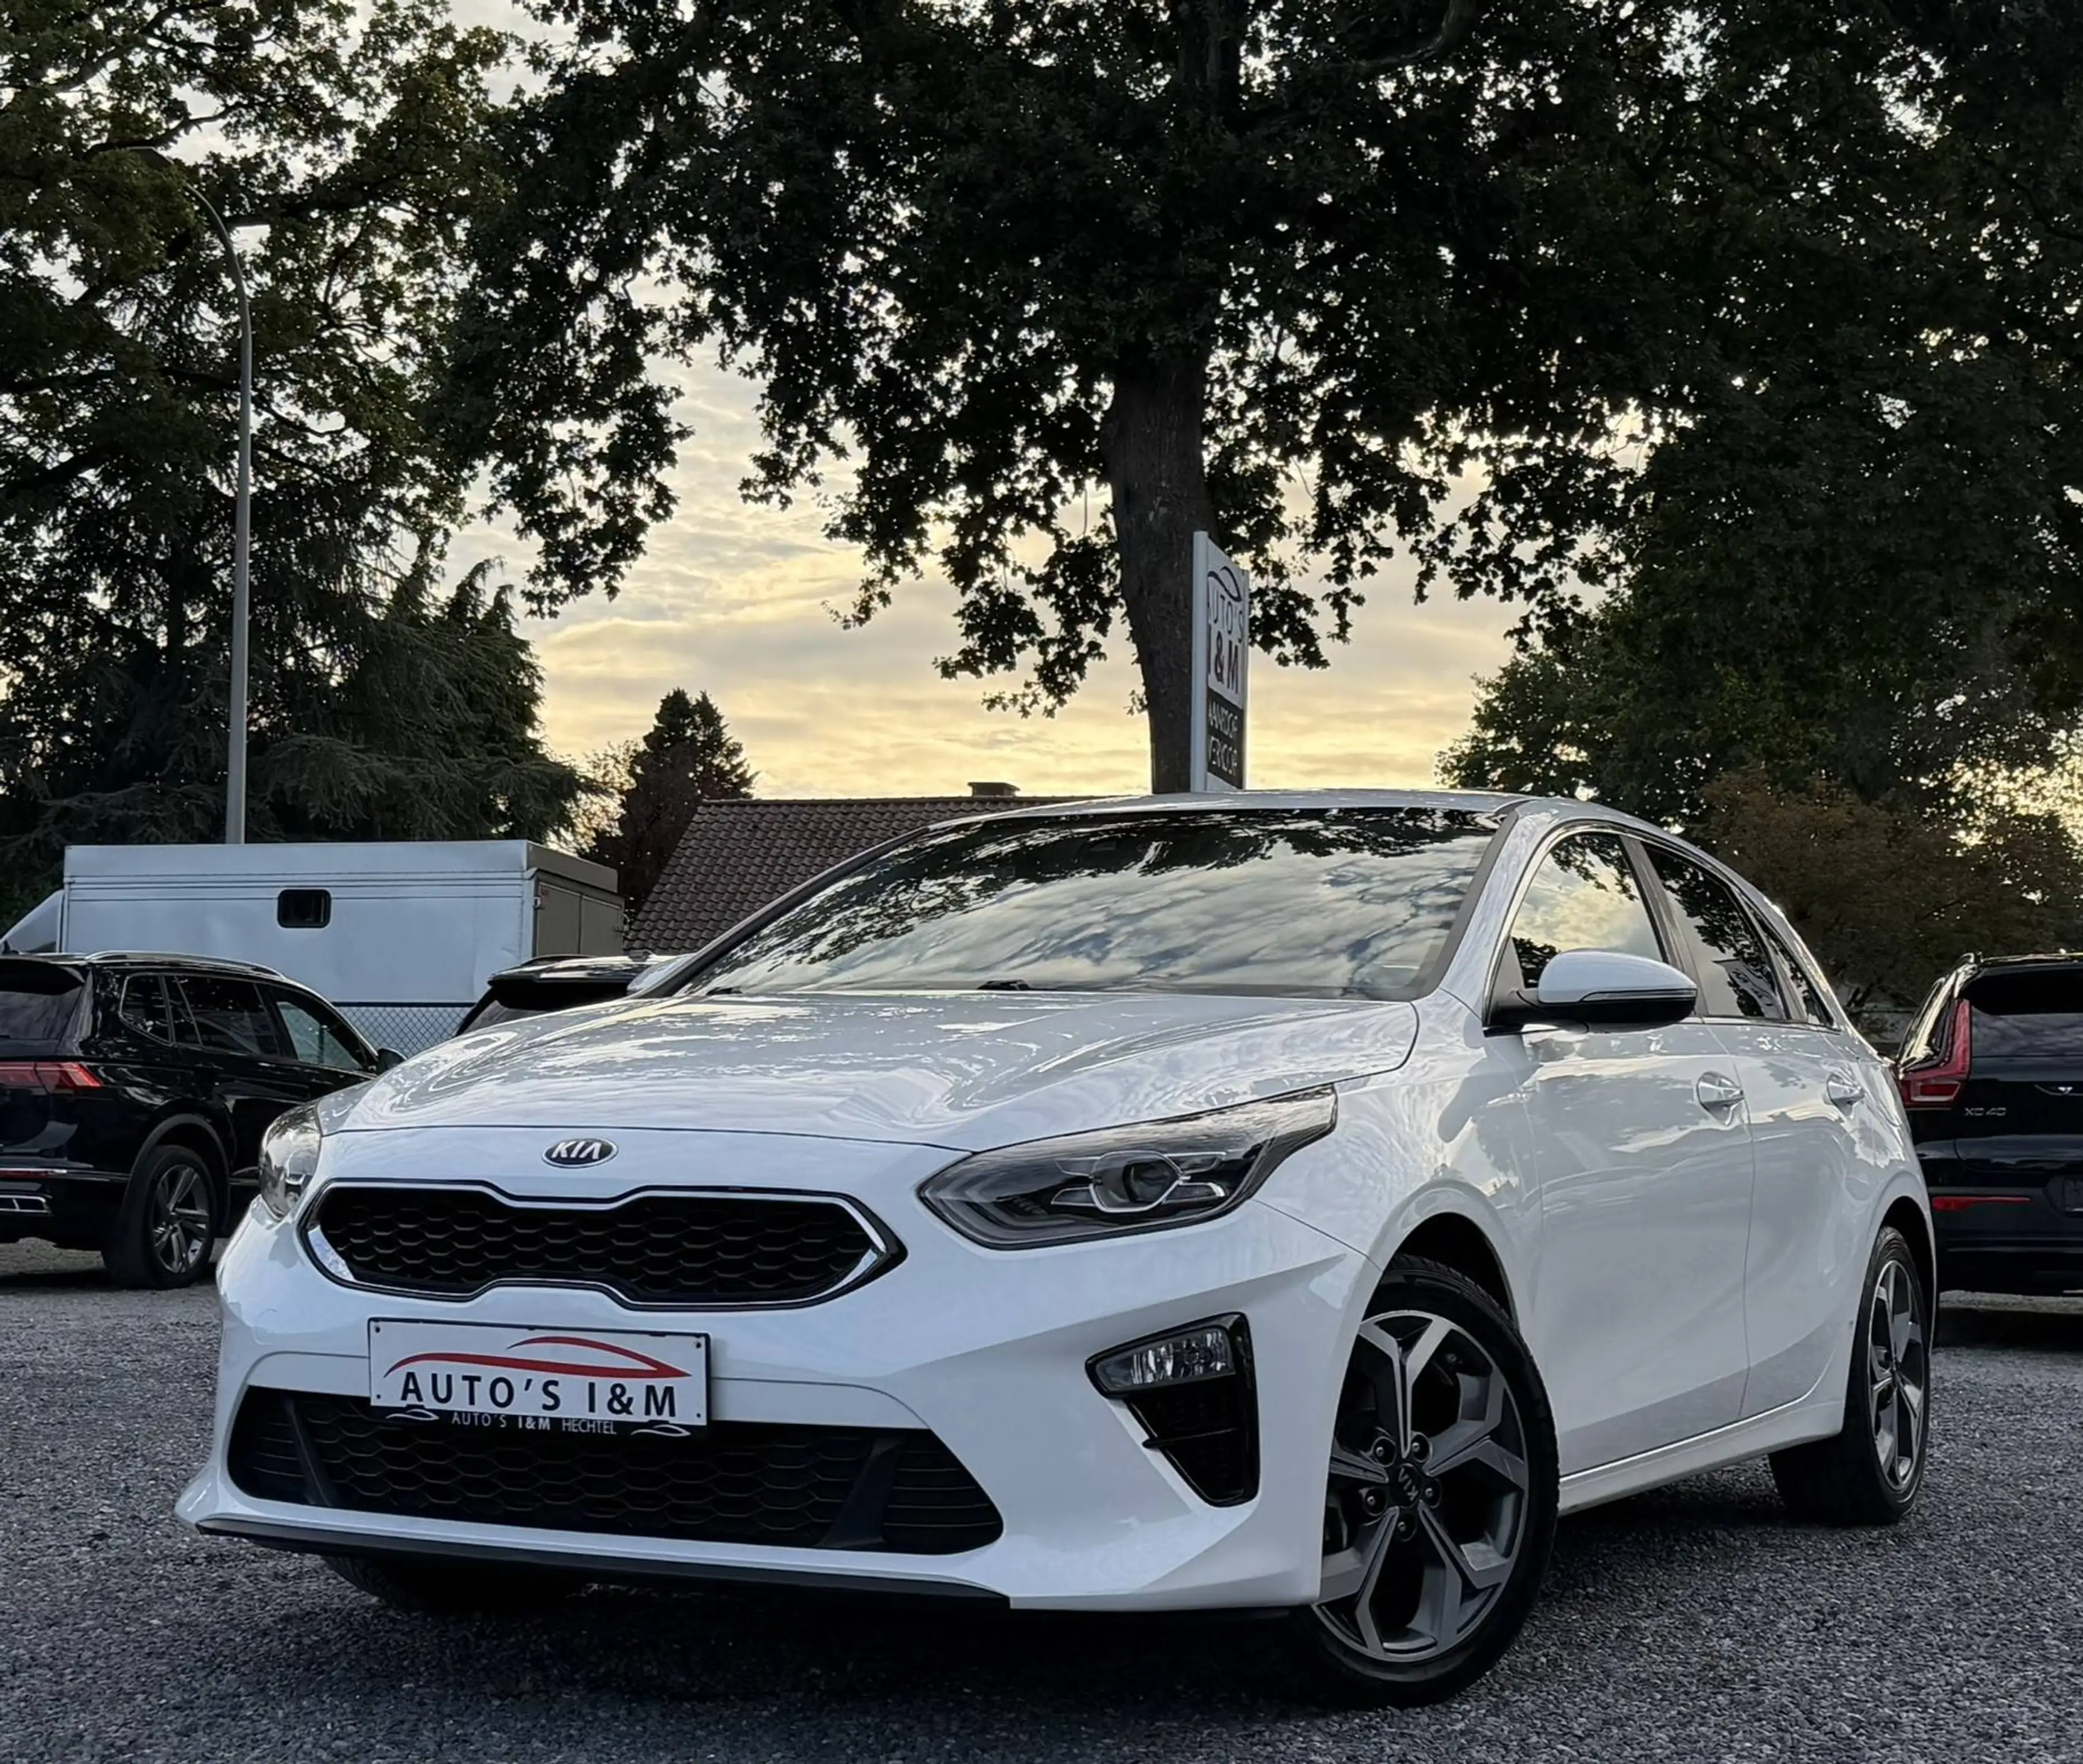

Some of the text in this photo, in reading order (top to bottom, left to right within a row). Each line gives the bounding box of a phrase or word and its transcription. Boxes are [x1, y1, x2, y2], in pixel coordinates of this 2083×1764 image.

[551, 1140, 602, 1160] KIA
[401, 1371, 676, 1417] AUTO'S I&M
[451, 1411, 617, 1434] AUTO'S I&M HECHTEL
[1398, 1467, 1420, 1501] KIA
